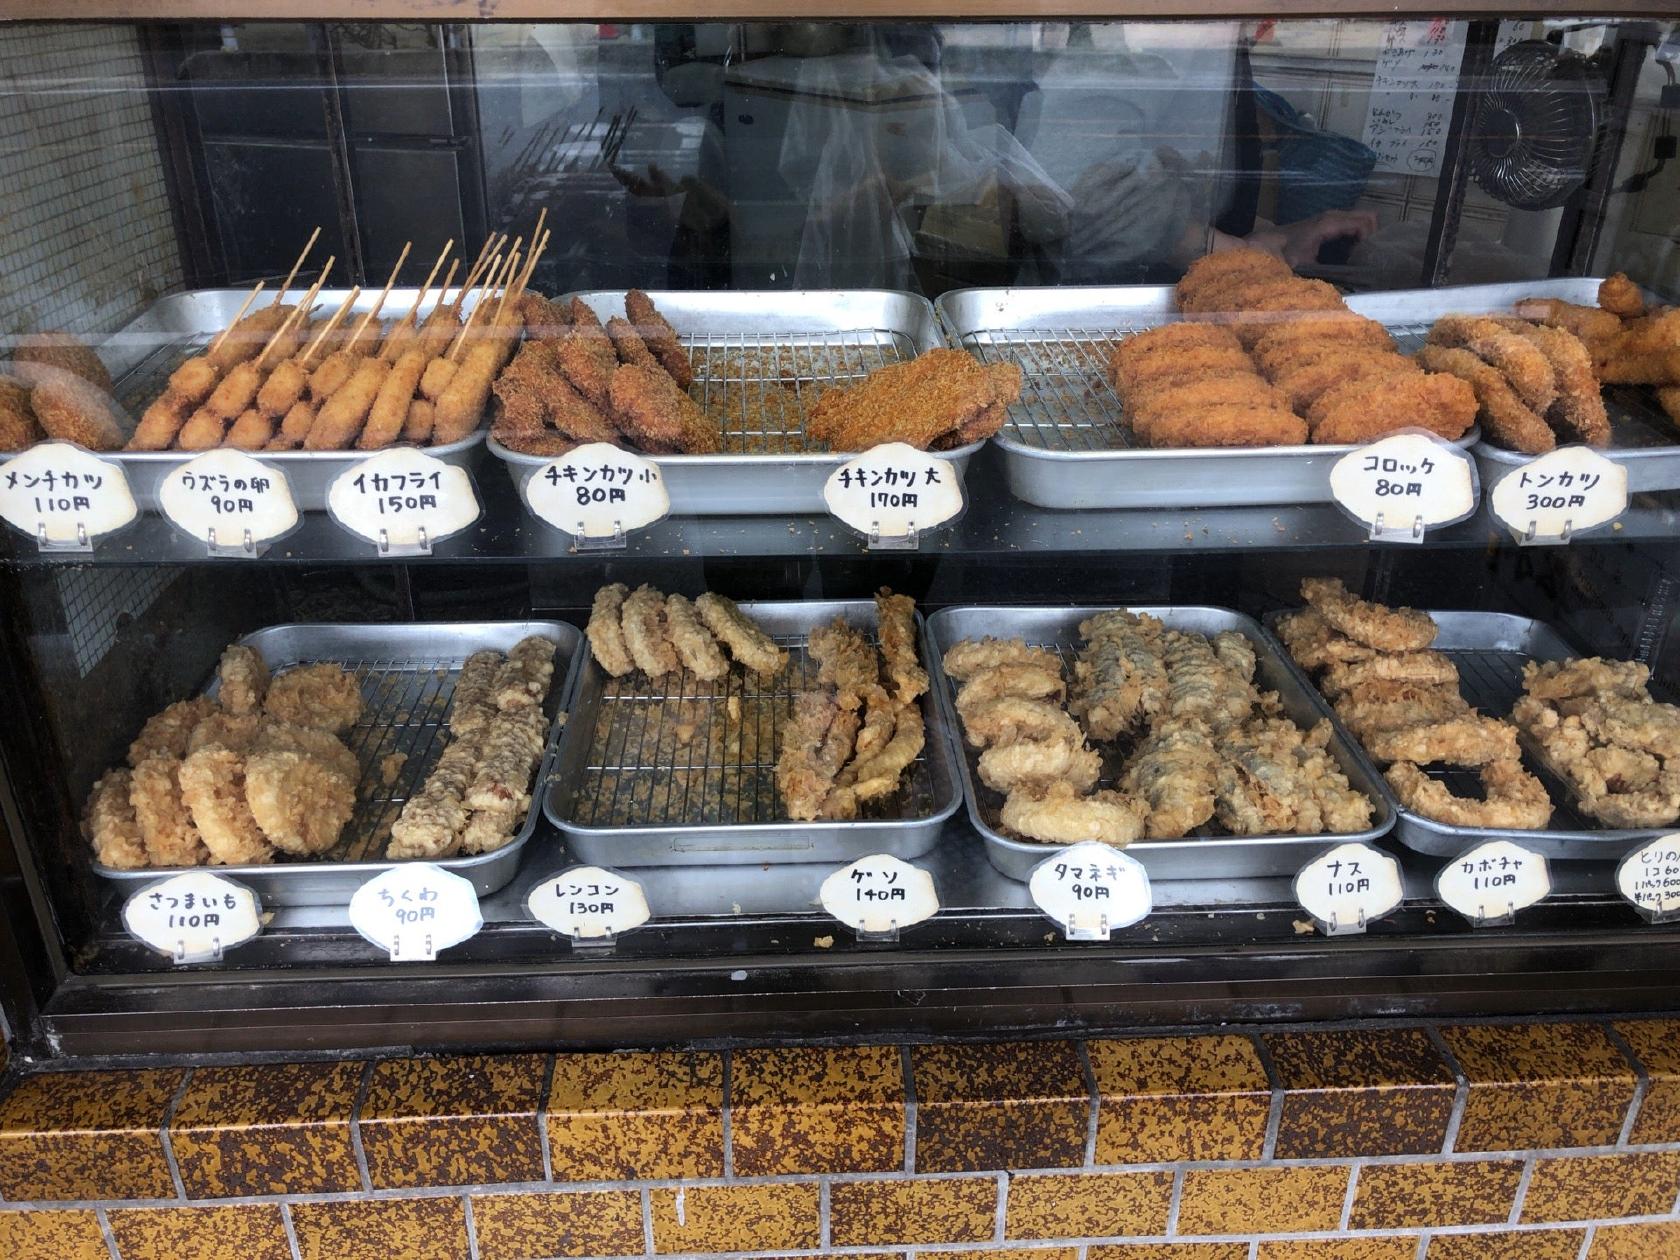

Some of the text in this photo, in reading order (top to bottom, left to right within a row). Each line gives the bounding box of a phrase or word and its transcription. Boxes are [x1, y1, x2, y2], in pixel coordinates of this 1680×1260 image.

[1363, 455, 1435, 475] コロッケ
[5, 469, 102, 492] メンチカツ
[182, 471, 270, 494] ウズラの卵
[353, 471, 441, 494] イカフライ
[1375, 478, 1422, 497] 80円
[1519, 471, 1601, 491] トンカツ
[34, 495, 90, 513] 110円
[210, 495, 254, 514] 90円
[378, 494, 437, 514] 150円
[576, 486, 626, 506] 80円
[870, 492, 918, 508] 170円
[1526, 494, 1586, 510] 300円
[1460, 857, 1524, 876] カボチャ
[1640, 851, 1680, 864] とりの
[850, 868, 898, 885] ゲソ
[1053, 860, 1127, 882] タマネギ
[1326, 860, 1362, 878] ナス
[555, 883, 619, 898] レンコン
[1328, 878, 1370, 896] 110円
[1474, 873, 1516, 890] 110円
[377, 886, 439, 908] ちくわ
[856, 887, 906, 901] 140円
[1071, 883, 1110, 901] 90円
[148, 892, 236, 911] さつまいも
[569, 902, 614, 915] 130円
[169, 913, 220, 928] 110円
[395, 907, 435, 925] 90円
